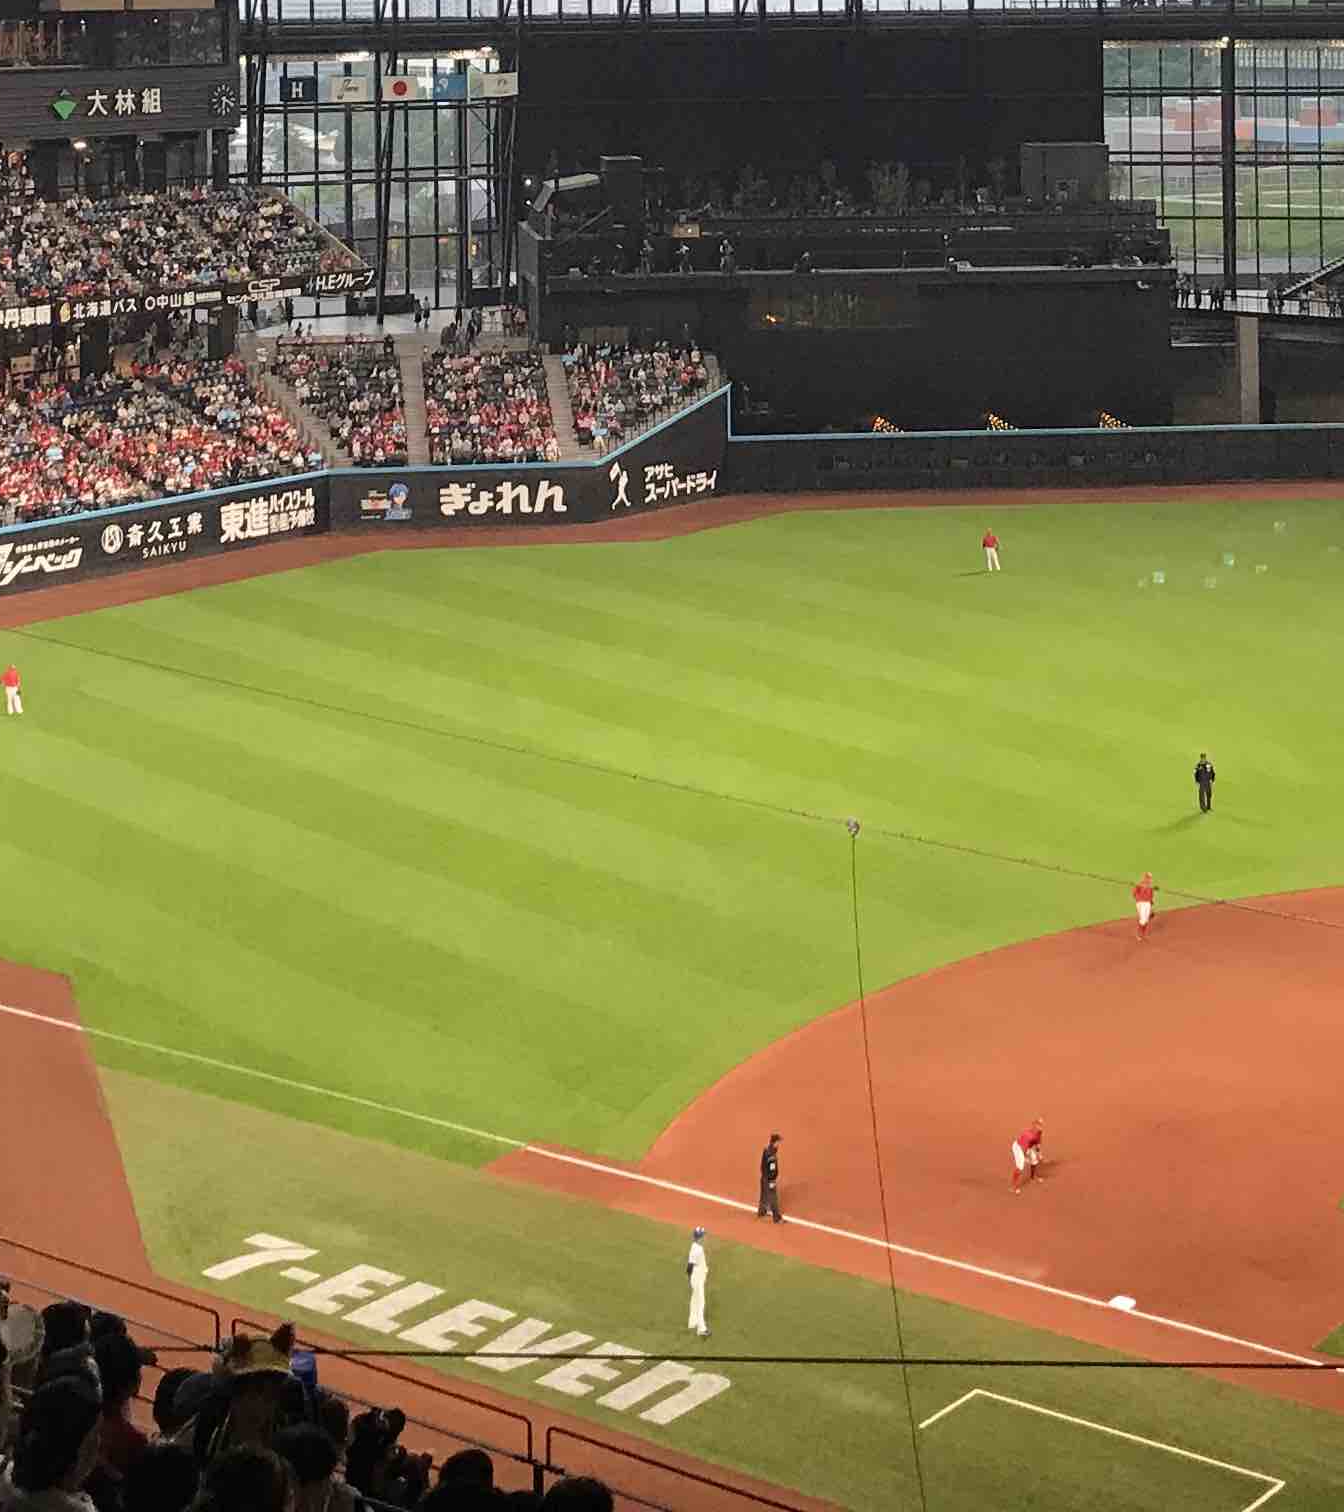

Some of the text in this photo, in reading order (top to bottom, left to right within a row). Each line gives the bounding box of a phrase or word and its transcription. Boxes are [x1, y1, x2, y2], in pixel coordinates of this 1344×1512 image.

[86, 88, 162, 117] 大林組
[72, 298, 138, 322] 北海道バス
[643, 462, 674, 483] アサヒ
[643, 469, 720, 505] スーパードライ
[269, 487, 316, 515] ハイスクール
[439, 480, 568, 517] ぎょれん
[219, 497, 270, 543] 東進
[142, 540, 187, 560] SAIKYU
[201, 1232, 731, 1425] 7-ELEVEN
